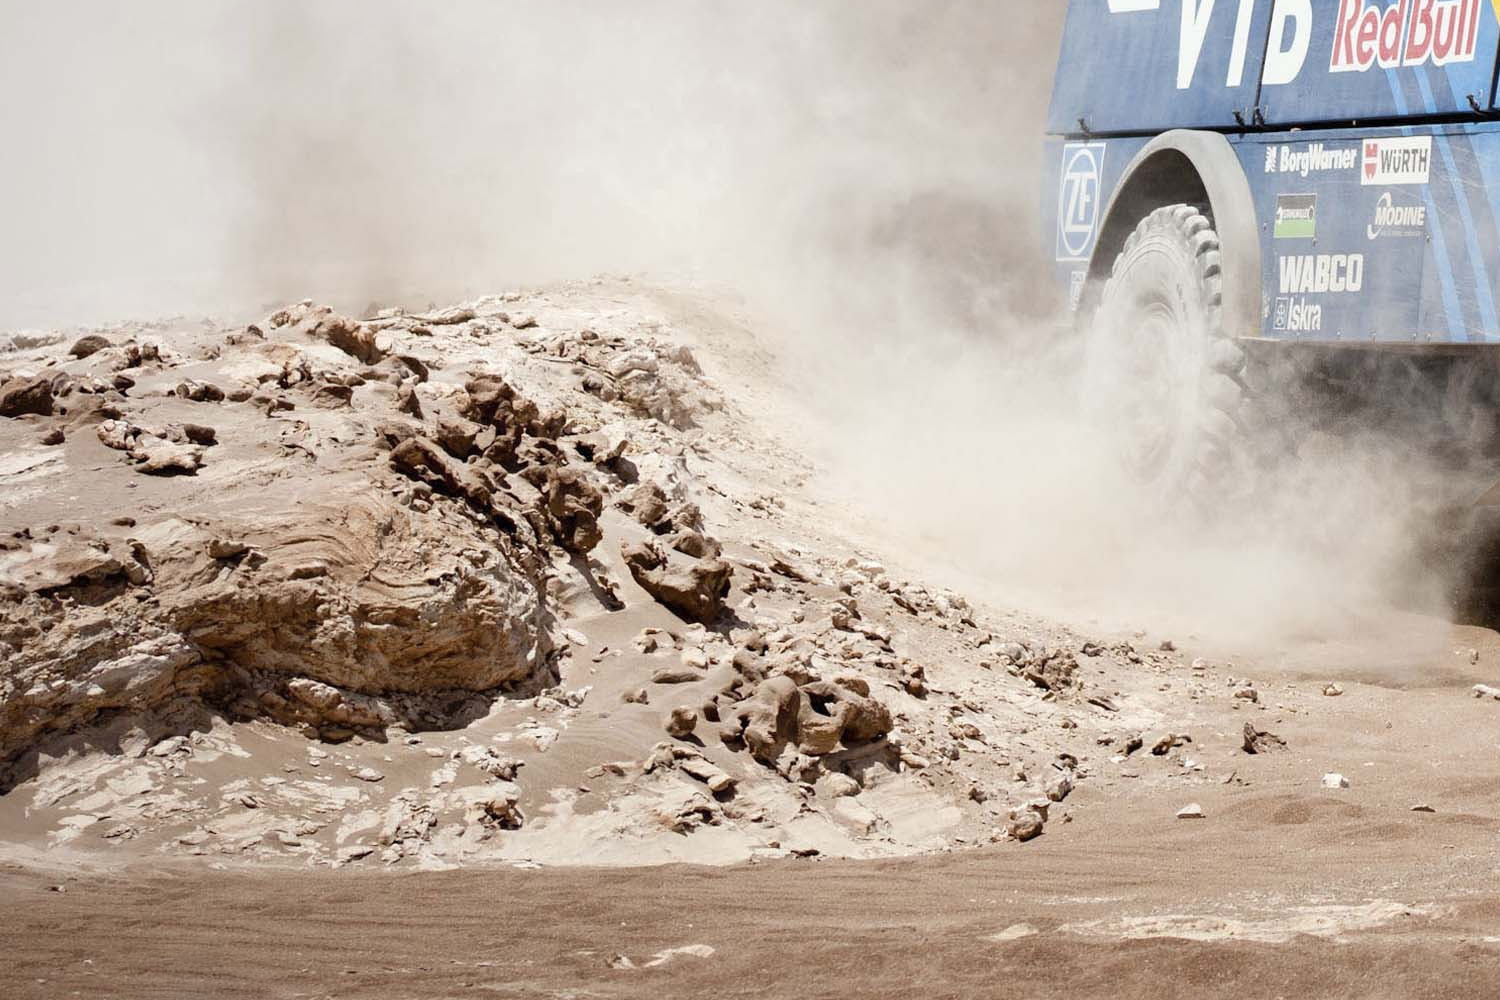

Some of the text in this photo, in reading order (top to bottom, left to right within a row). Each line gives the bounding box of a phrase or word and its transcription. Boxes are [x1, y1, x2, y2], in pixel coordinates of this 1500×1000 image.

[1279, 143, 1358, 178] BorgWarner
[1380, 147, 1429, 173] WÜRTH
[1374, 205, 1426, 226] MODINE
[1279, 253, 1365, 294] WABCO
[1286, 297, 1322, 331] Iskra
